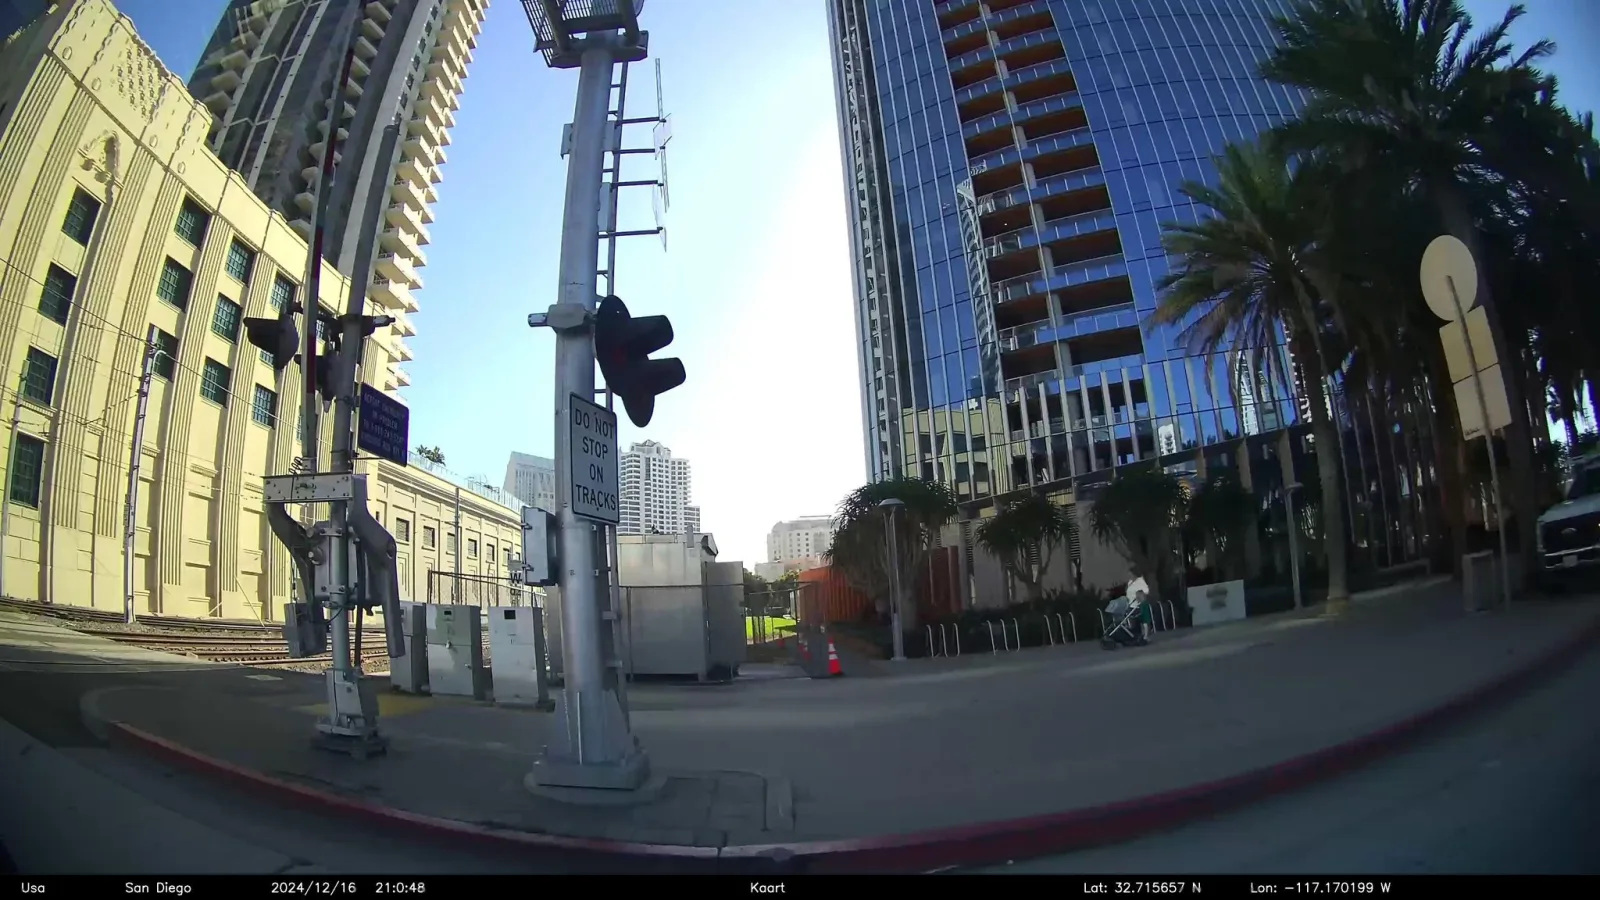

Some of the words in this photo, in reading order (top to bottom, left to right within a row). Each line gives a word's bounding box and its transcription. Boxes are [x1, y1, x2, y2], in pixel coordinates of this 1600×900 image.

[575, 408, 590, 429] DO
[595, 416, 614, 439] NOT
[582, 436, 608, 460] STOP
[589, 463, 604, 483] ON
[575, 484, 616, 511] TRACKS
